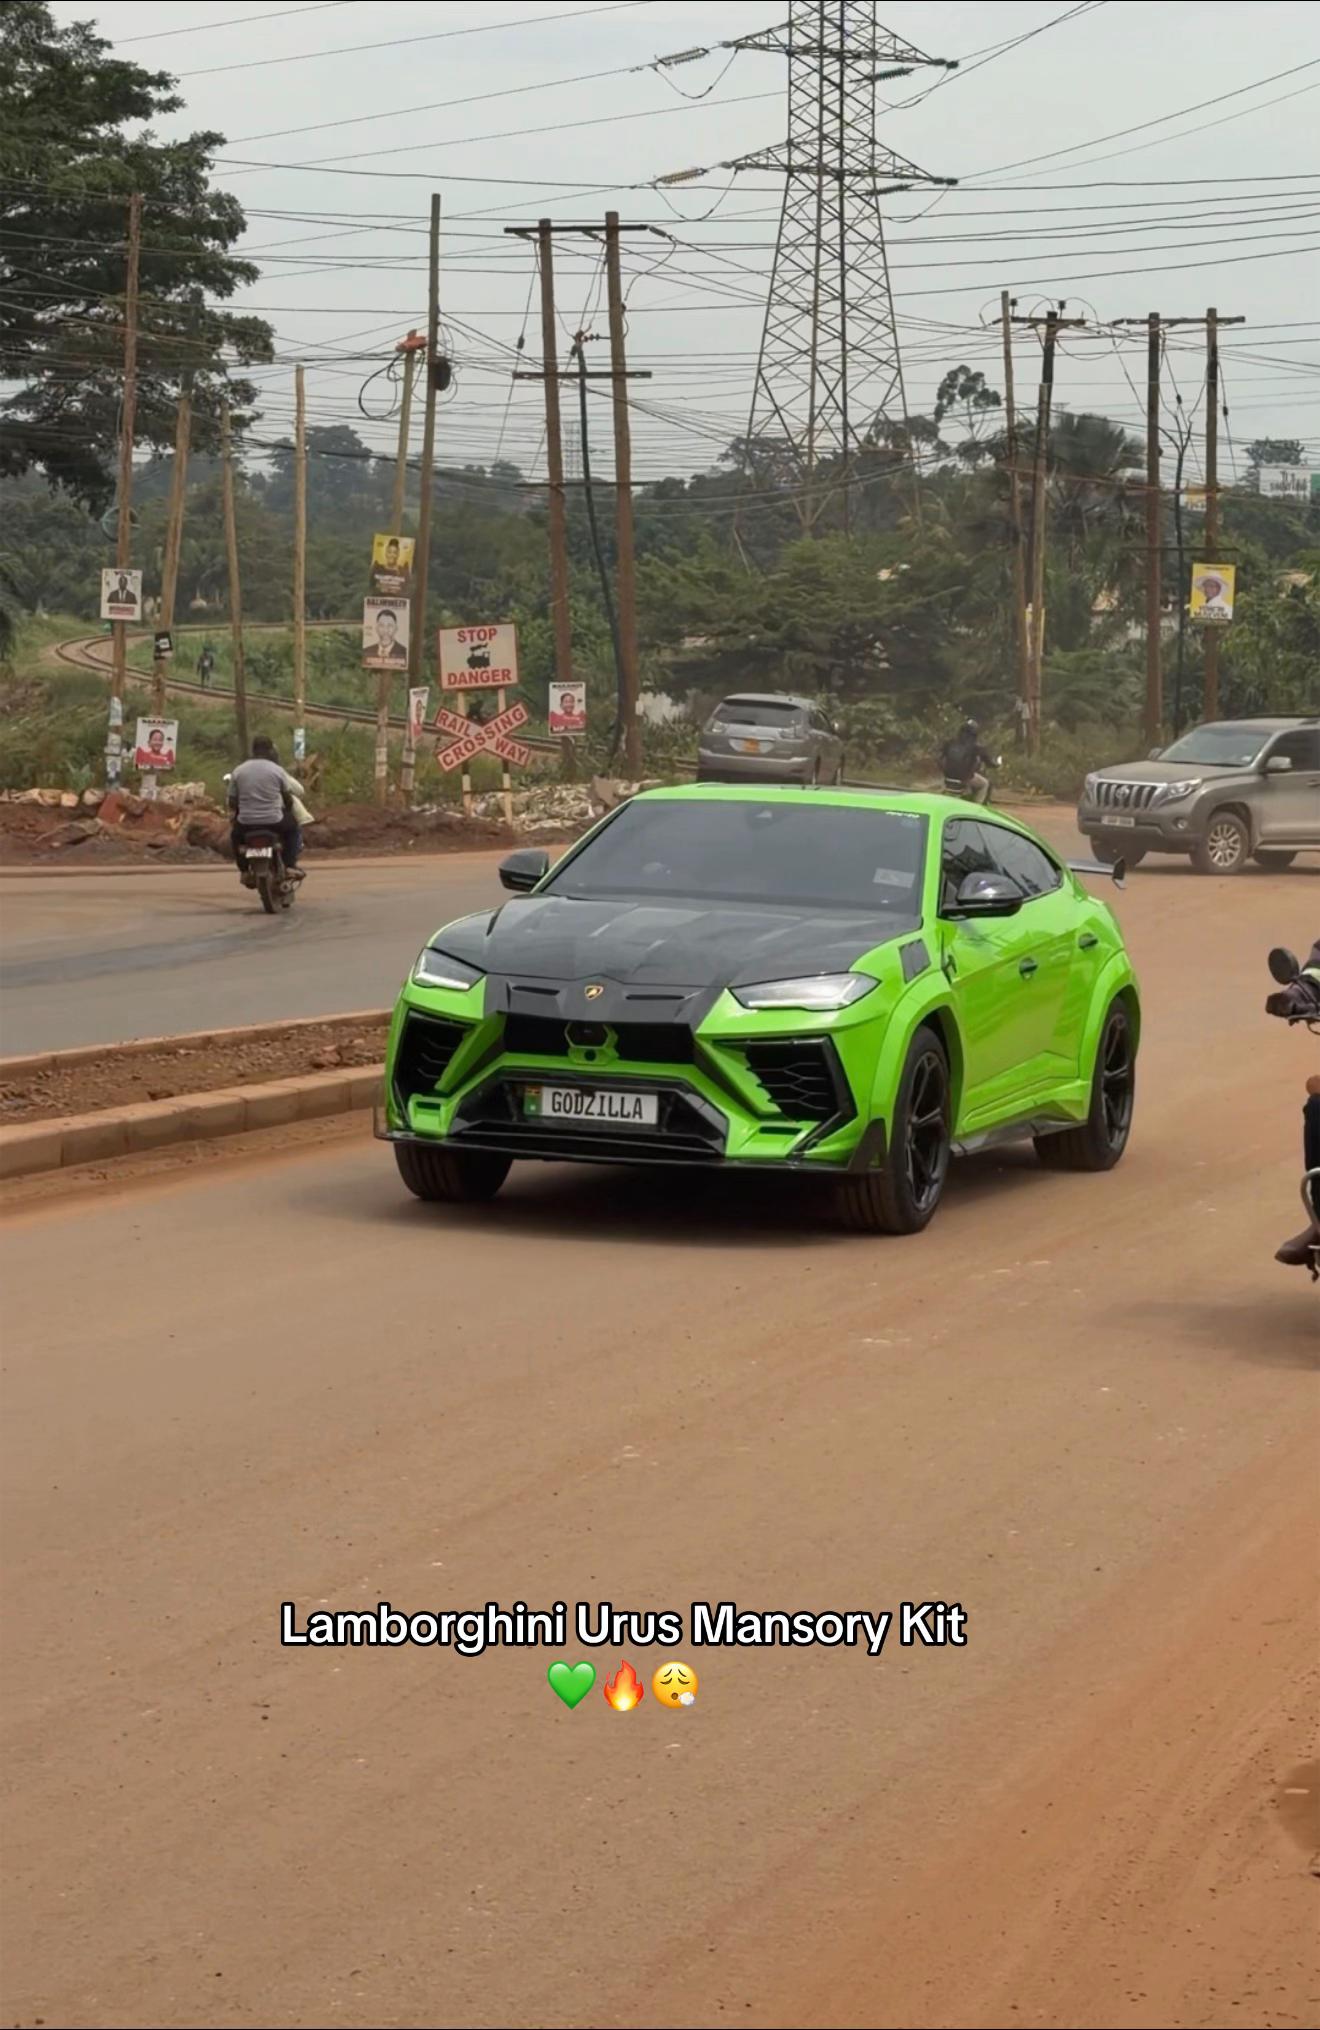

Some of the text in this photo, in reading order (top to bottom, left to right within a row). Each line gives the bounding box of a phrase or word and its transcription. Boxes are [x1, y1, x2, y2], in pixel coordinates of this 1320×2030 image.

[457, 628, 497, 643] STOP
[448, 669, 512, 686] DANGER
[437, 710, 528, 762] RAIL WAY
[442, 707, 525, 767] CROSSING
[551, 1091, 643, 1120] GODZILLA
